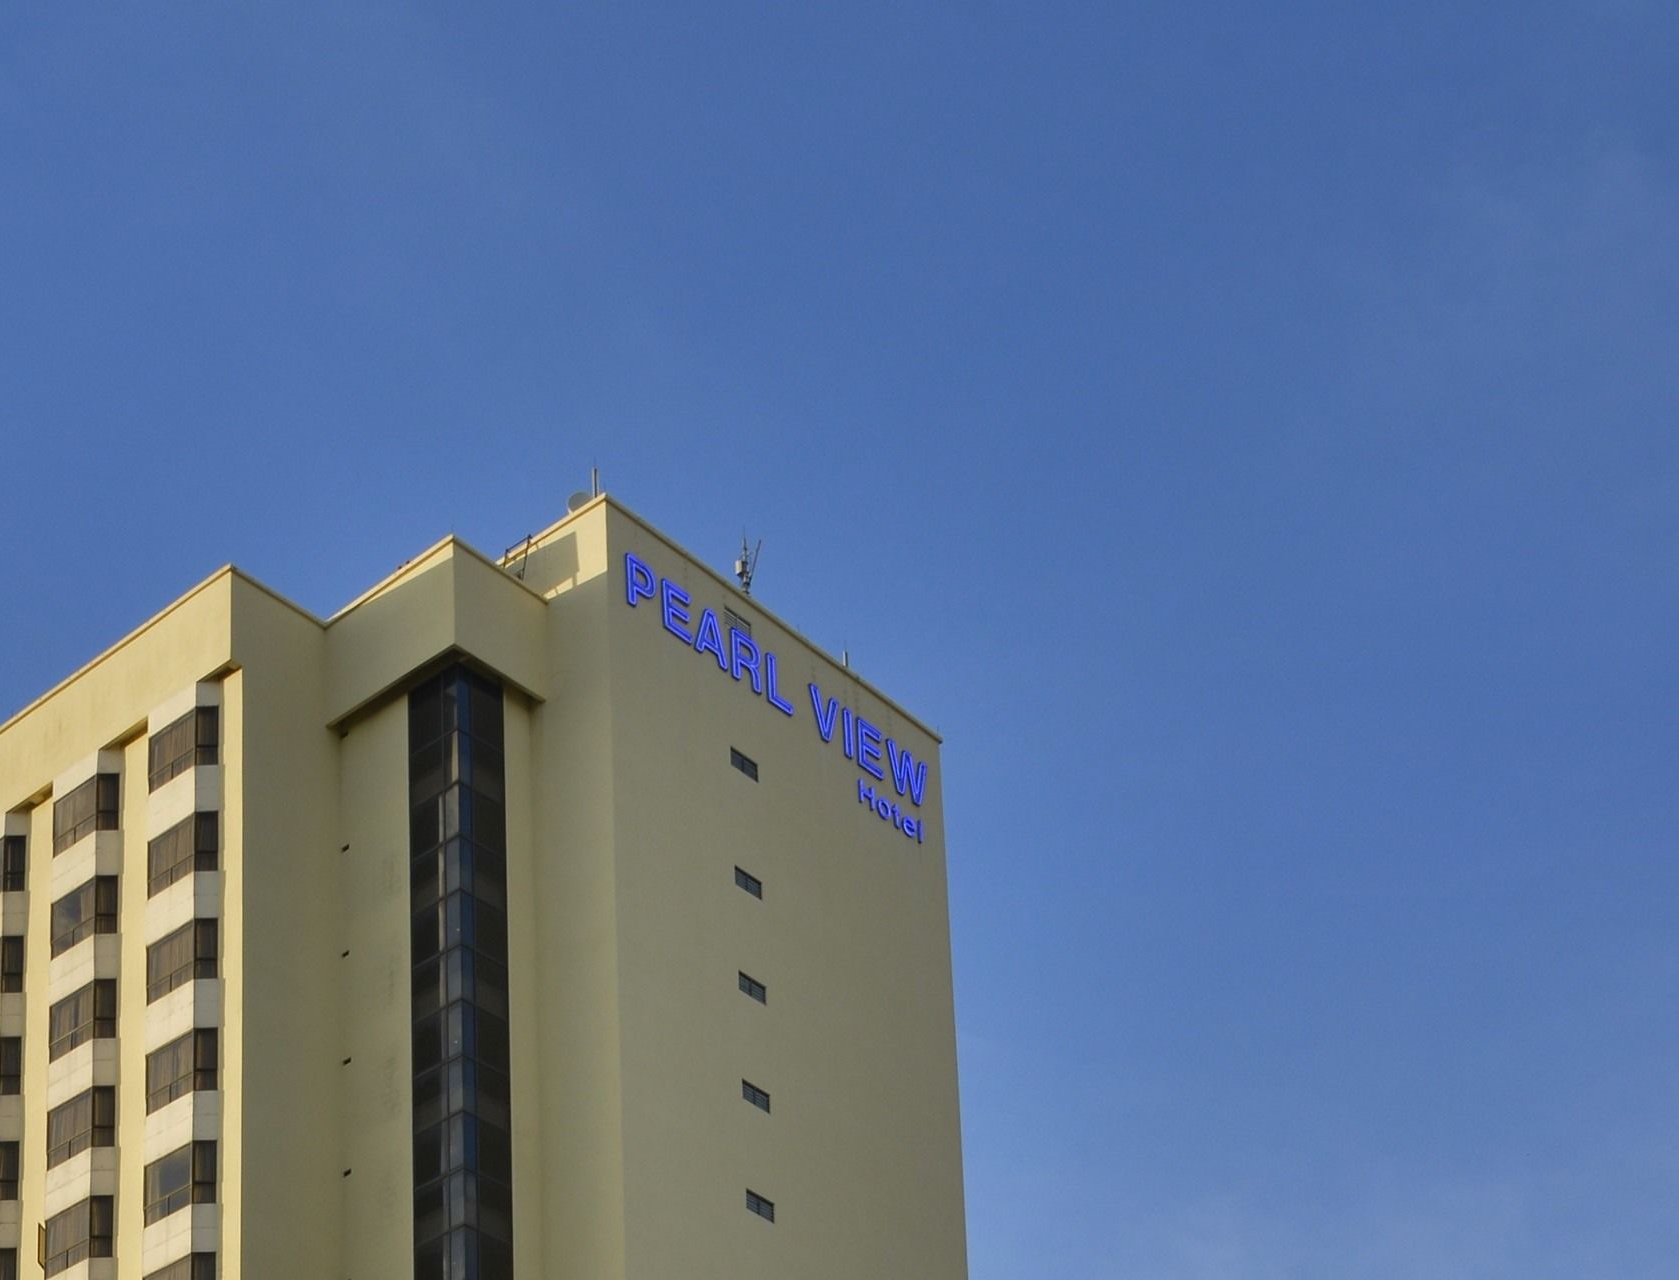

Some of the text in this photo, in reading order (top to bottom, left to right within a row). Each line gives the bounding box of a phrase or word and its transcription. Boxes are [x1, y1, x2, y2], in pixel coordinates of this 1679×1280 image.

[625, 551, 928, 807] PEARL VIEW
[857, 778, 925, 844] Hotel
